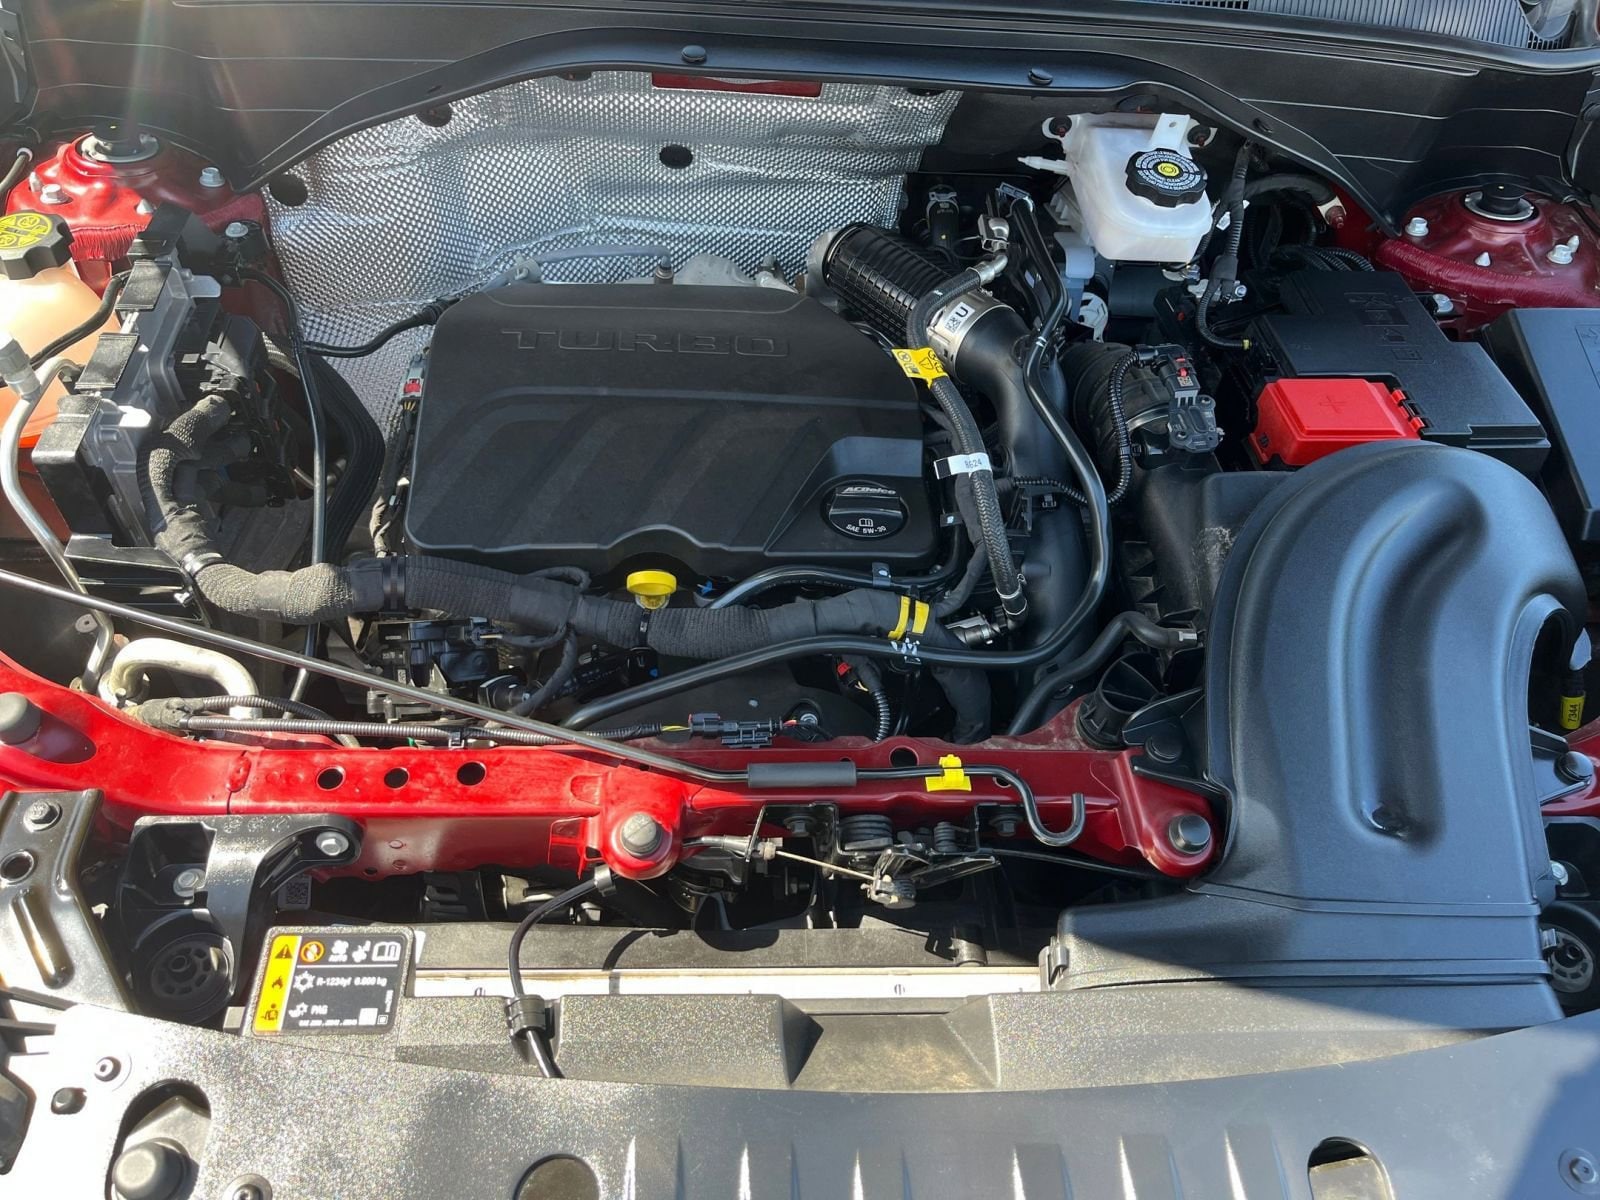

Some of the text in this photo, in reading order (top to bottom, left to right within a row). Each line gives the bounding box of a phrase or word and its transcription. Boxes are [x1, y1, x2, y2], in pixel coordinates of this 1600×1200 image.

[956, 307, 968, 318] U
[501, 330, 789, 357] TURBO
[841, 486, 897, 495] ACDelco
[845, 524, 860, 533] SAE
[1568, 703, 1578, 722] 7344
[310, 1005, 328, 1015] PAG
